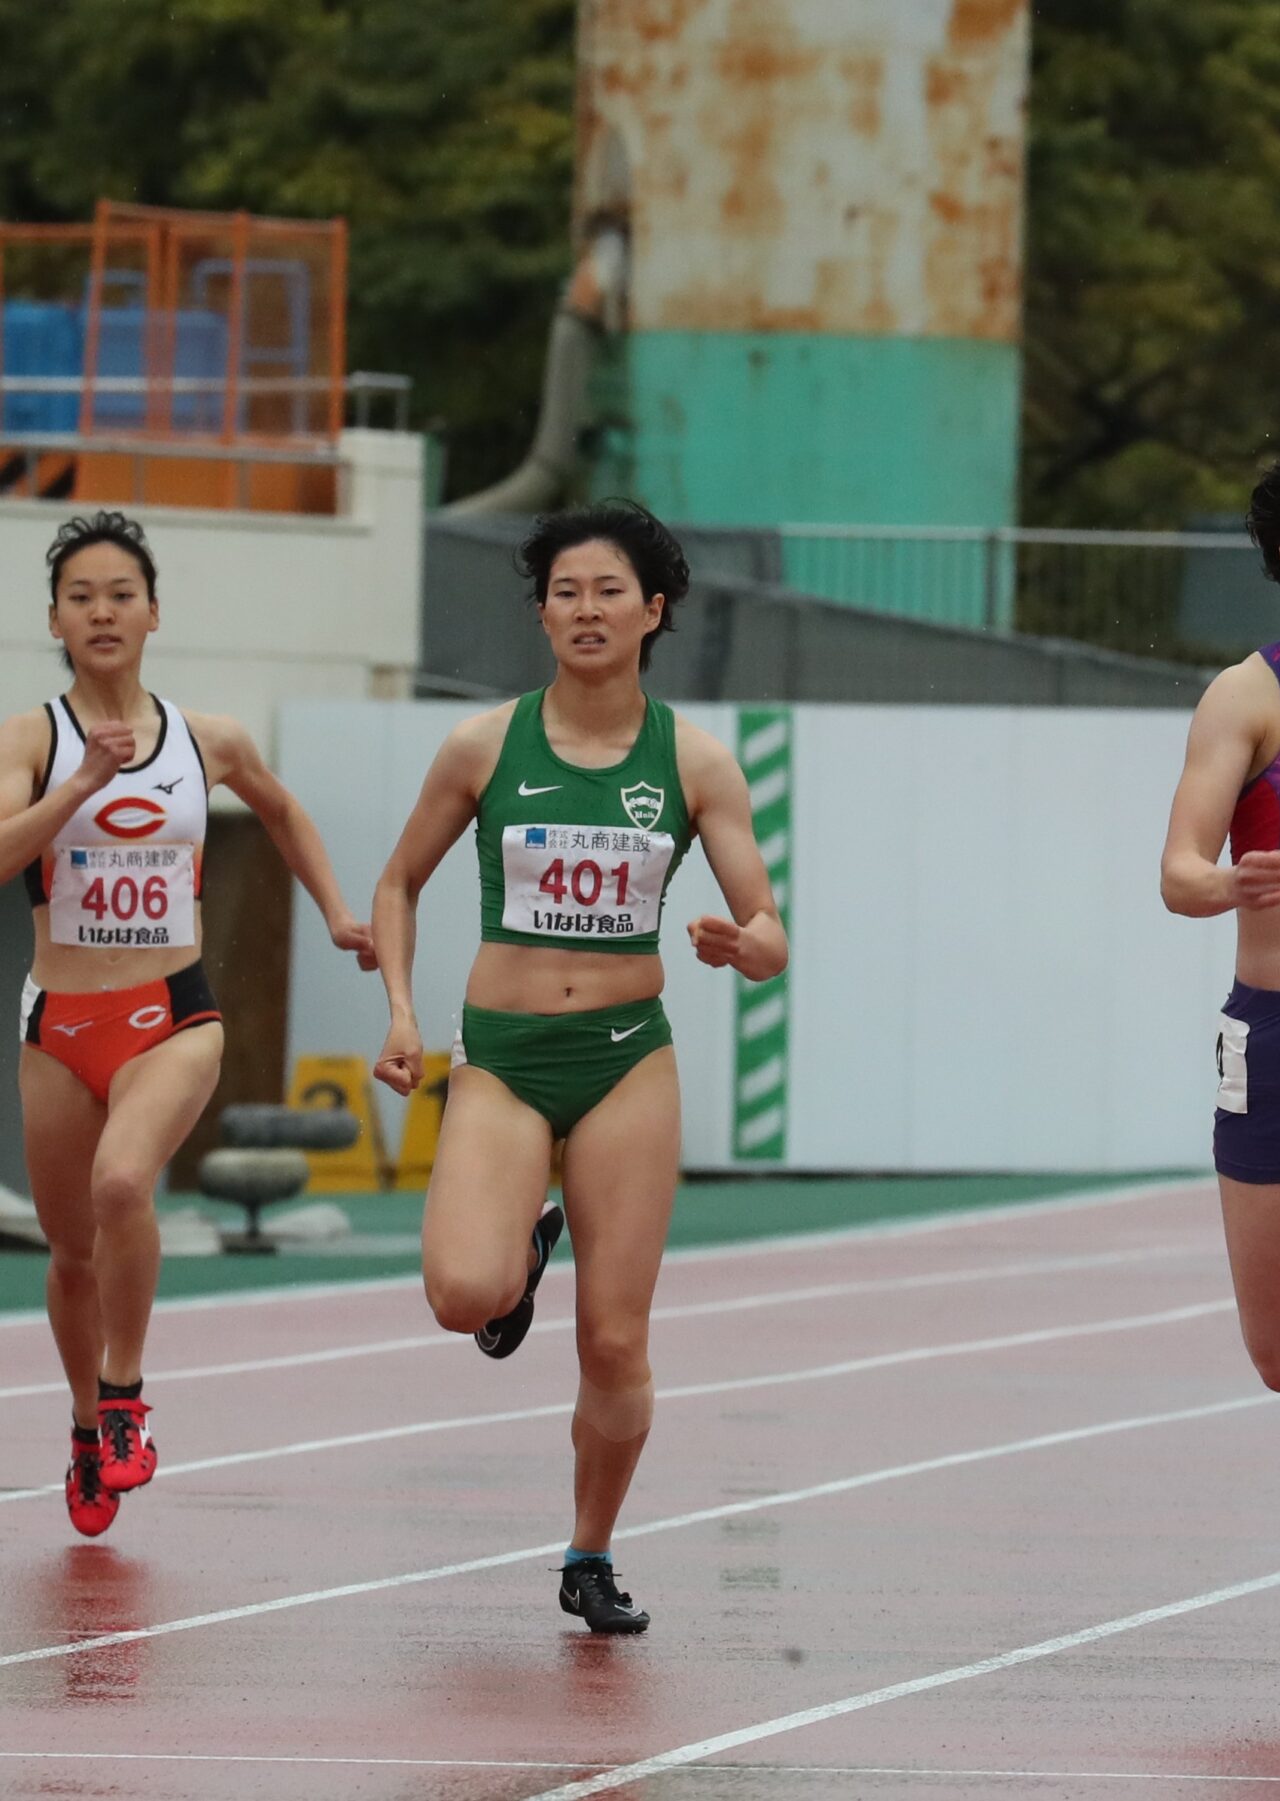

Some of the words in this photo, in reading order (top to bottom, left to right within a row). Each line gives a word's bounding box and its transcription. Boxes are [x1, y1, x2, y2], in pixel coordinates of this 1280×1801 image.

[570, 830, 652, 853] 丸商建設
[108, 849, 178, 867] 丸商建設
[538, 857, 631, 907] 401
[80, 874, 168, 922] 406
[534, 910, 634, 934] いなば食品
[78, 924, 170, 945] いなば食品
